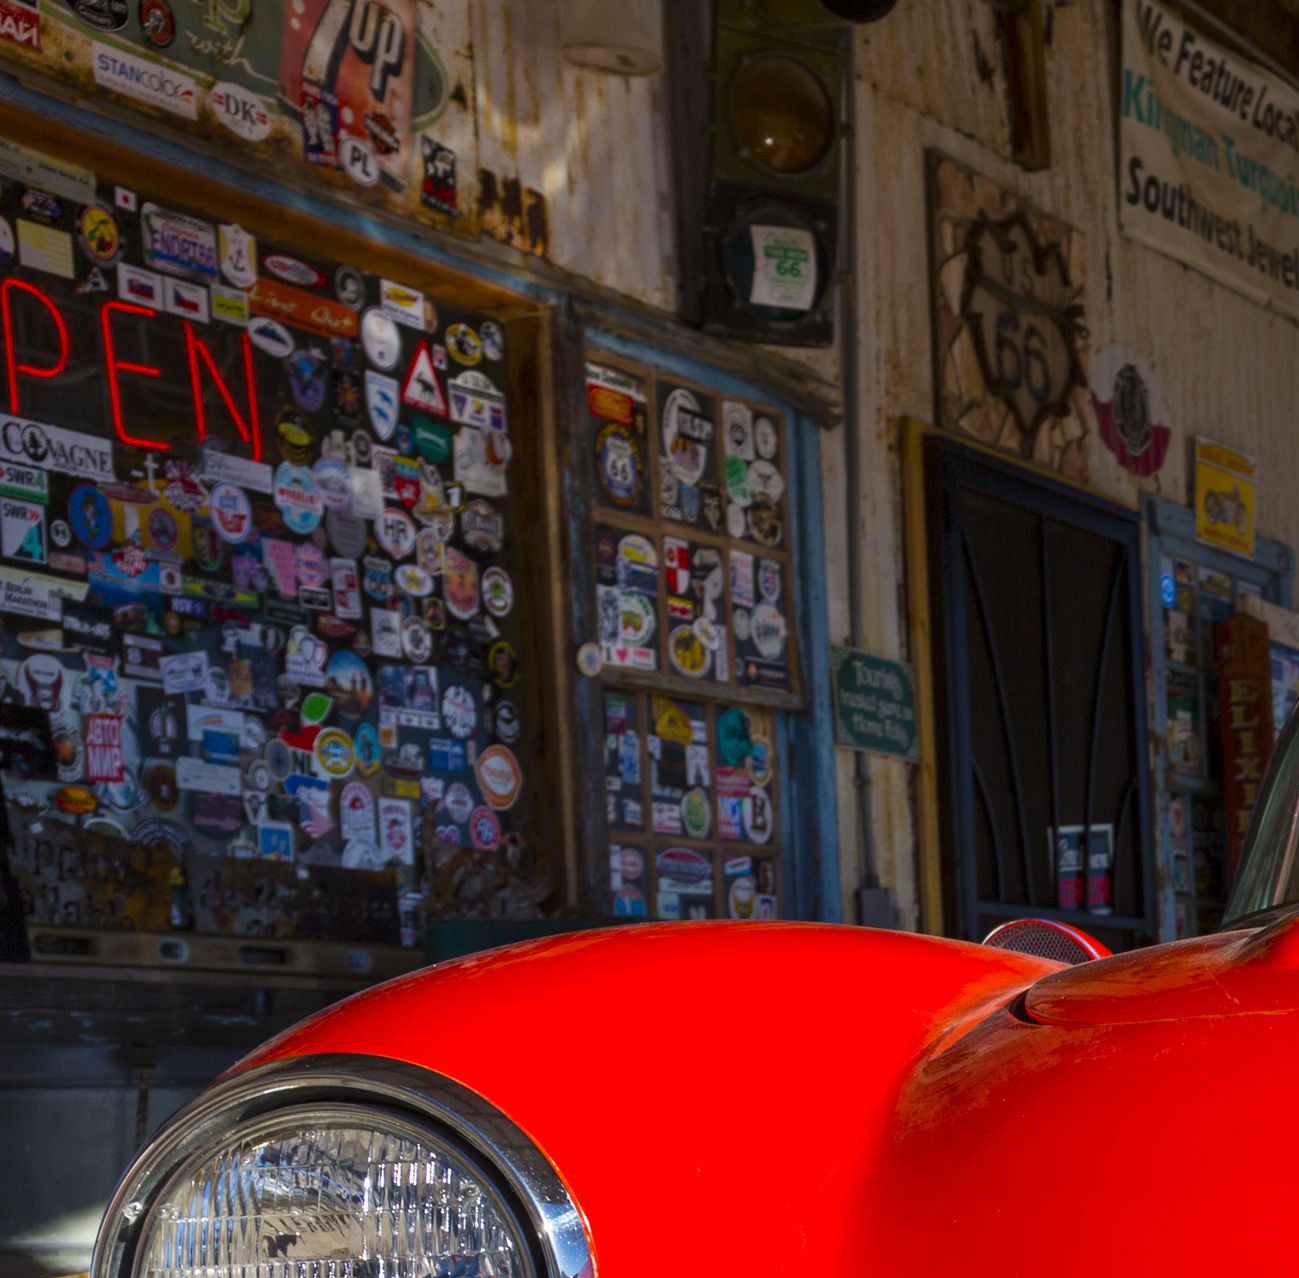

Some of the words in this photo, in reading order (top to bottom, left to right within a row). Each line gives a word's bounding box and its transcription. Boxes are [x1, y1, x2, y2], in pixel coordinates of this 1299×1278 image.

[1174, 30, 1254, 120] Feature
[224, 92, 258, 125] DK
[351, 146, 371, 178] PL
[1126, 156, 1244, 260] Southwest
[776, 259, 801, 277] 66
[998, 310, 1051, 401] 66
[610, 459, 628, 482] 66
[384, 517, 408, 540] HR
[87, 746, 121, 780] МИР
